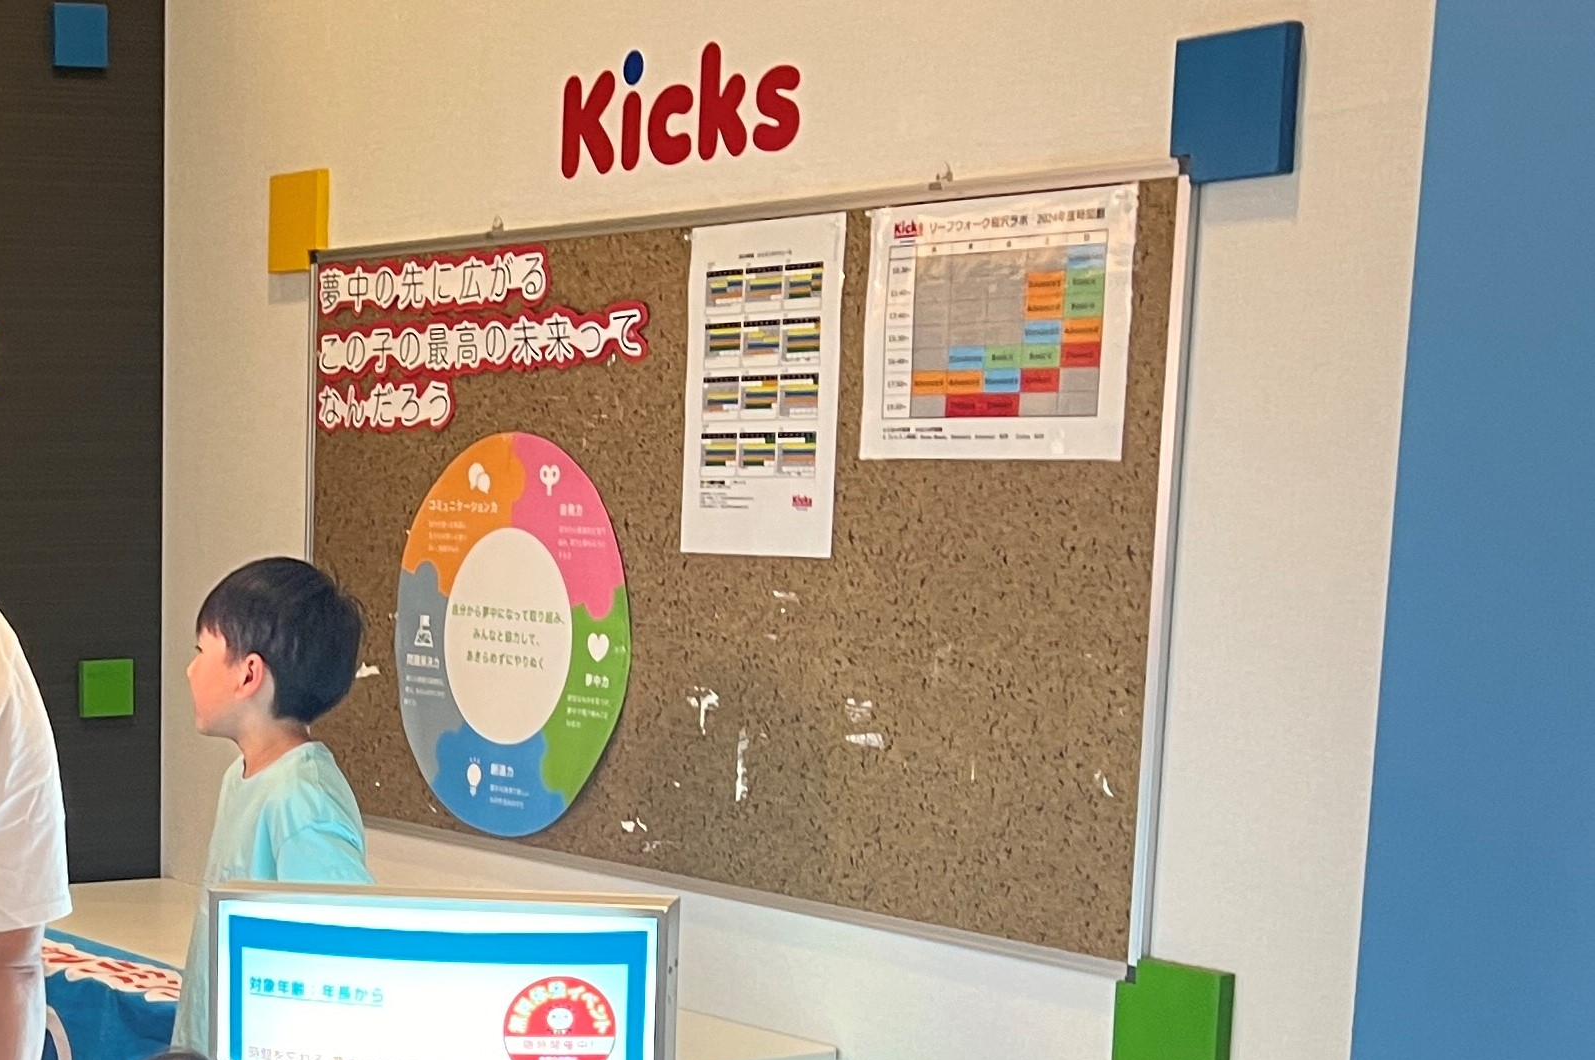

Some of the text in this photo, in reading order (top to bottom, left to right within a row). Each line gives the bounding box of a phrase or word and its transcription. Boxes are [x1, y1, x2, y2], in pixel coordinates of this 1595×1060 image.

[561, 41, 801, 179] Kicks
[321, 255, 546, 309] 夢中の先に広がる
[319, 308, 642, 371] この子の最高の未来って
[319, 383, 451, 425] なんだろう
[466, 650, 545, 671] あきらめずにやりぬく
